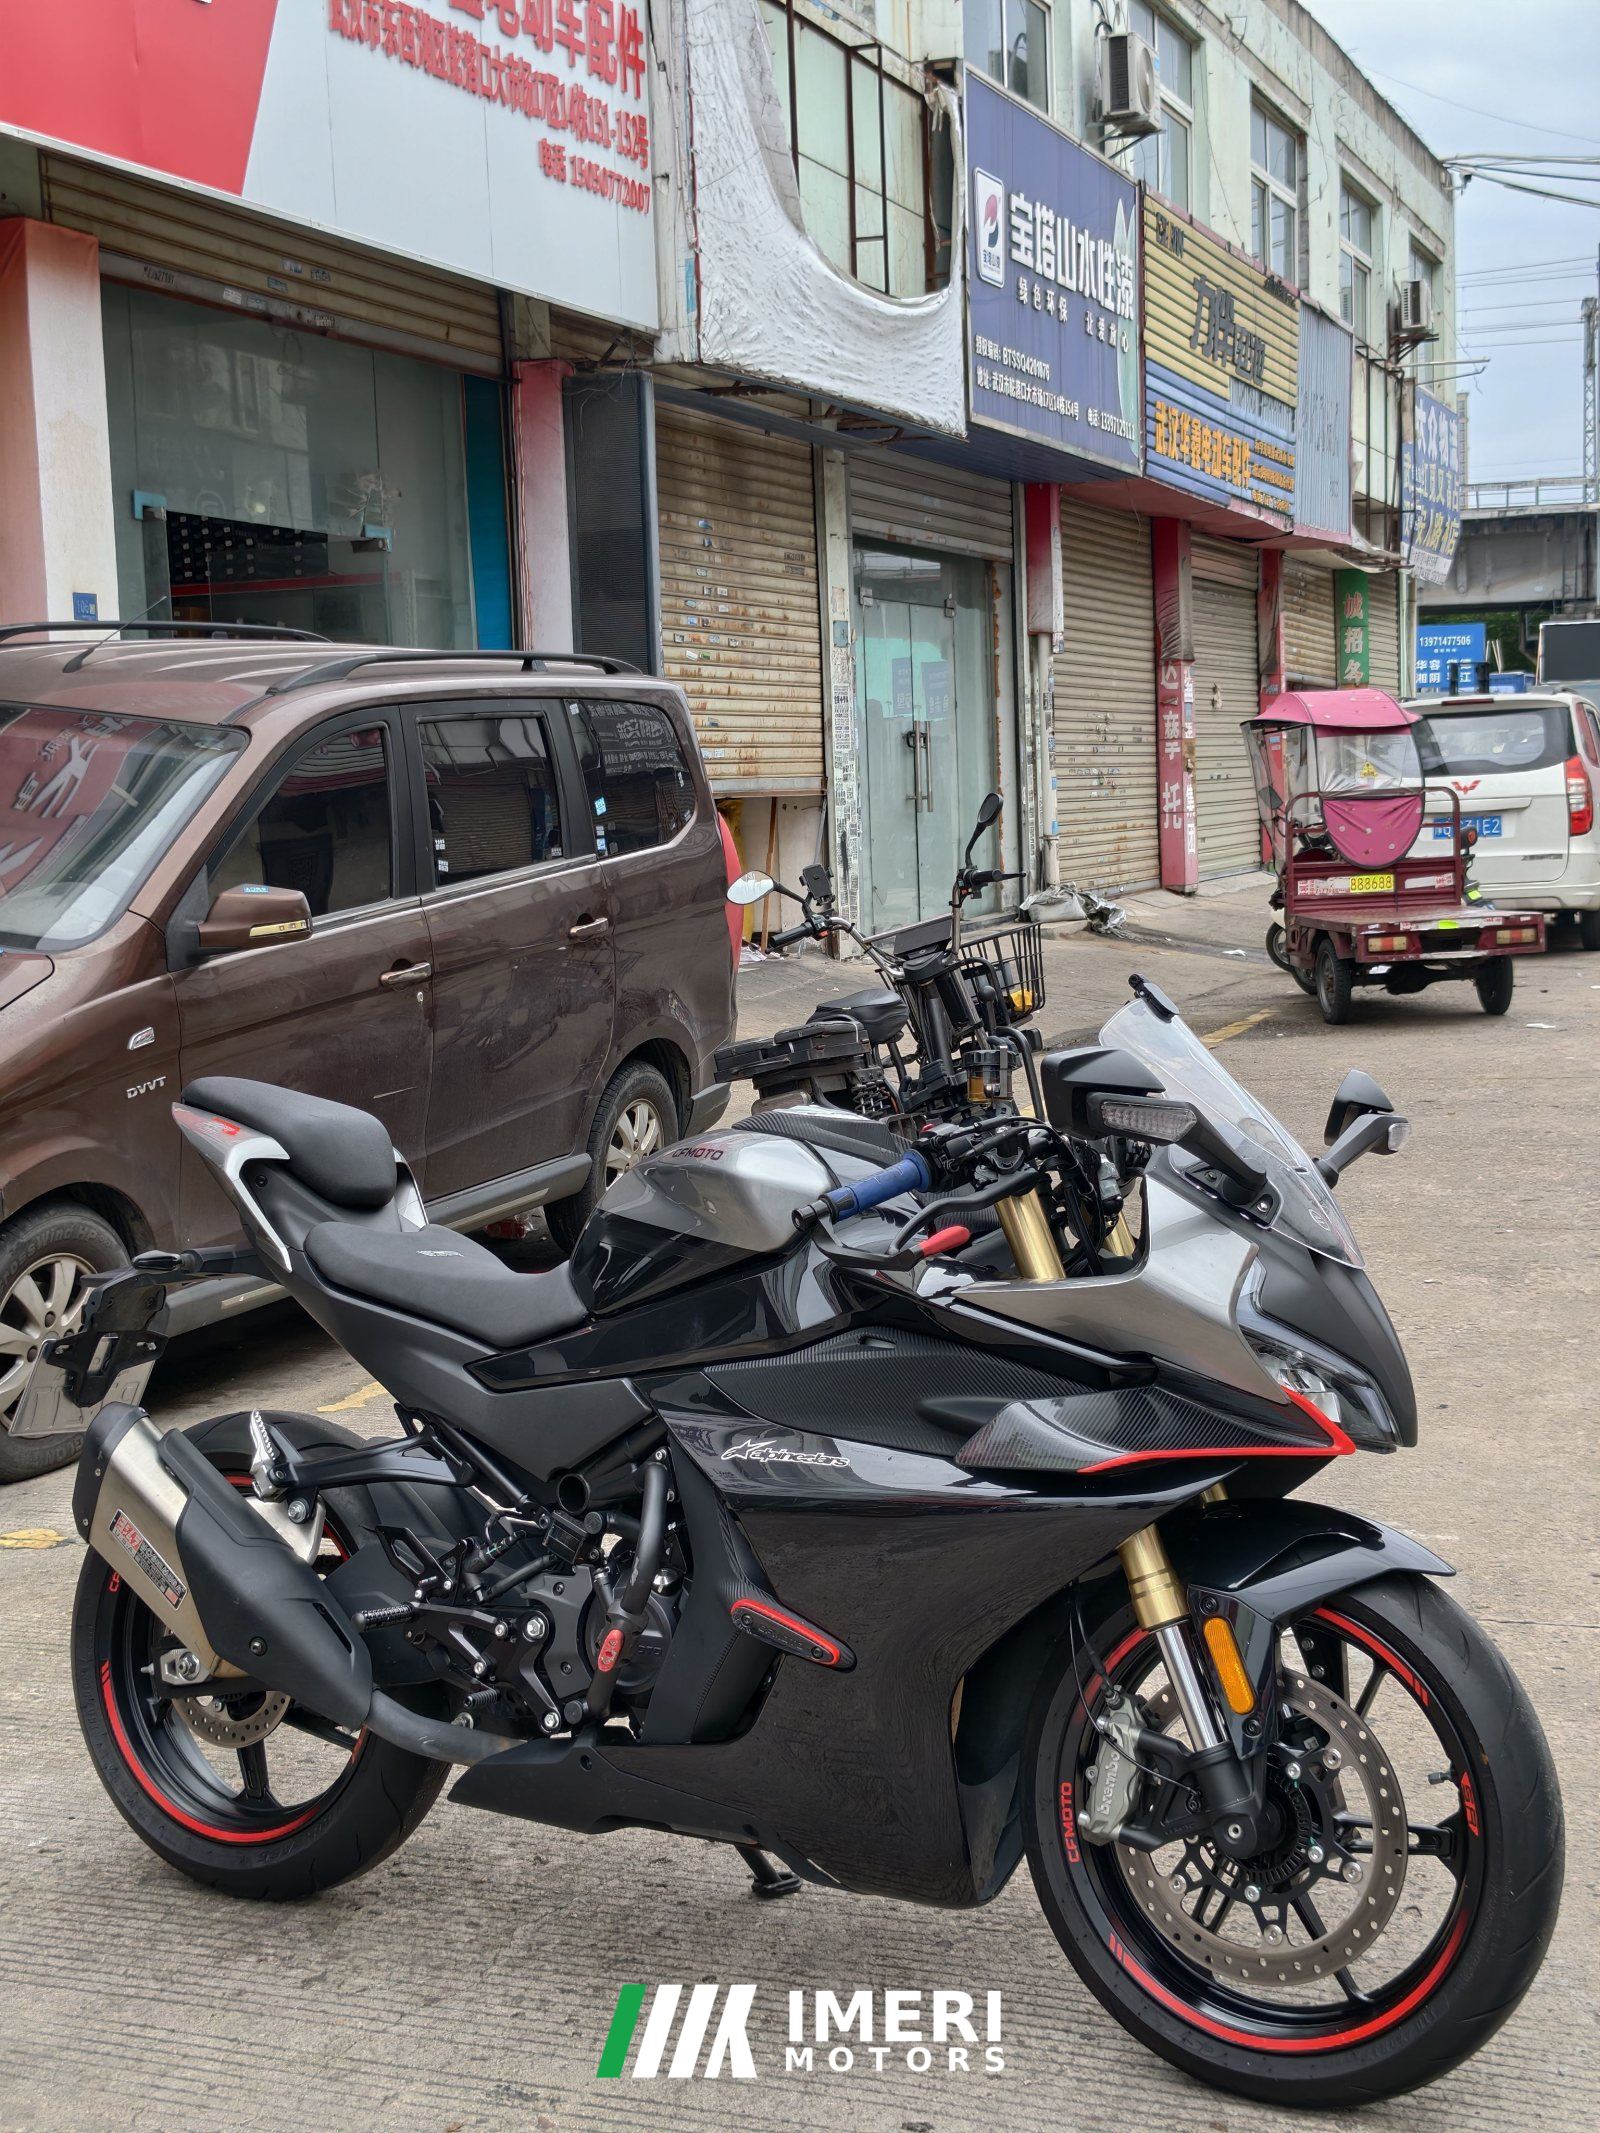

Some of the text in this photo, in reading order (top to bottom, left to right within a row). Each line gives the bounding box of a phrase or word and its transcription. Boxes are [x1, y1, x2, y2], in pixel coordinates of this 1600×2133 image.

[449, 0, 646, 98] 动车配件
[1420, 635, 1471, 647] 13971477506
[126, 1075, 167, 1100] DVVT
[672, 1148, 724, 1161] CFMOTO
[1098, 1751, 1121, 1816] brembo
[1060, 1781, 1081, 1863] CFMOTO
